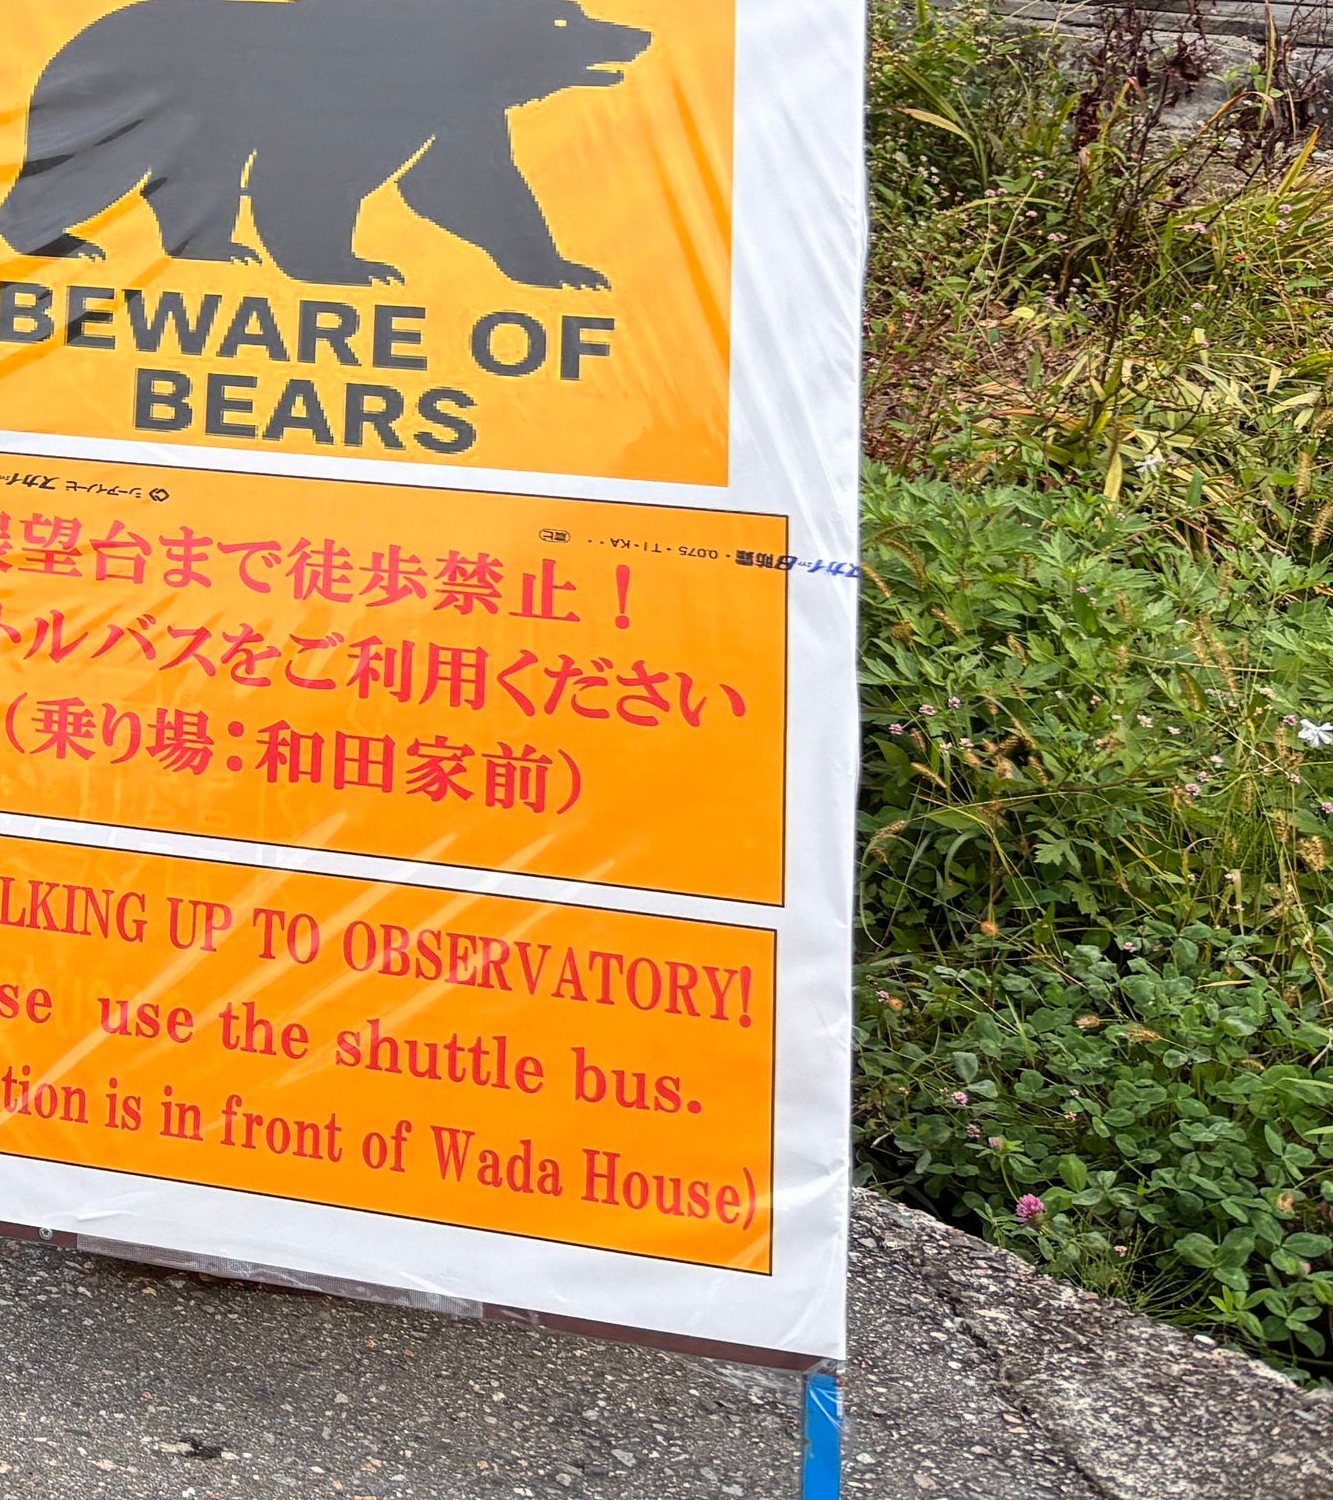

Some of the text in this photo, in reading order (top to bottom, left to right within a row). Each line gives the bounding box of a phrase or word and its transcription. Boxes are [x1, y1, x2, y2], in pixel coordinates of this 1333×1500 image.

[471, 312, 615, 380] OF
[135, 368, 476, 455] BEARS
[166, 896, 233, 954] UP
[252, 907, 320, 965] TO
[343, 920, 753, 1029] OBSERVATORY!
[97, 997, 194, 1044] use
[218, 1001, 309, 1060] the
[335, 1018, 545, 1094] shuttle
[570, 1046, 703, 1116] bus.
[104, 1077, 142, 1132] is
[159, 1084, 205, 1142] in
[220, 1094, 343, 1163] front
[361, 1118, 413, 1173] of
[429, 1125, 564, 1198] Wada
[580, 1148, 757, 1231] House)
